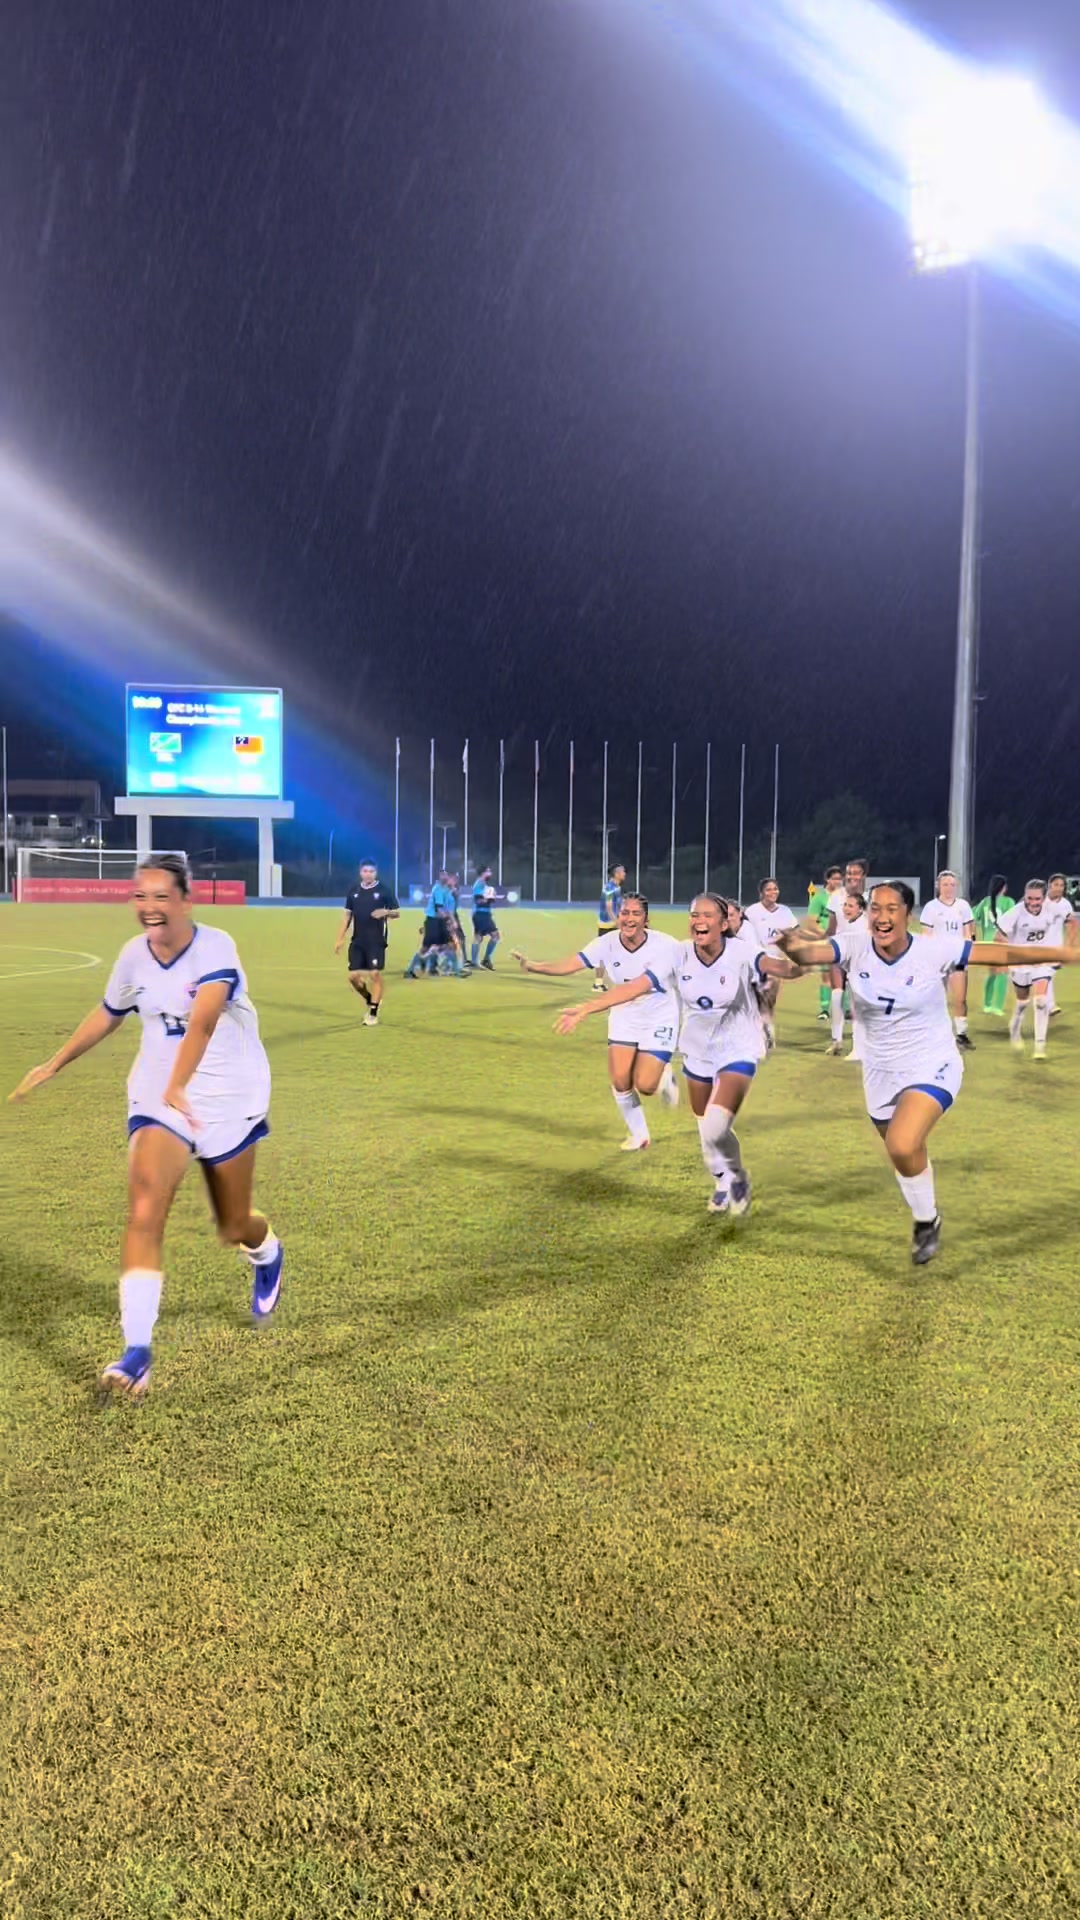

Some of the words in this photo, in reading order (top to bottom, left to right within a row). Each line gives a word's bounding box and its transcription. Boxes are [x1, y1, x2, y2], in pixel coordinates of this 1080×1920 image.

[945, 920, 958, 932] 14
[1026, 930, 1045, 942] 20
[877, 996, 896, 1016] 7
[653, 1026, 674, 1041] 21
